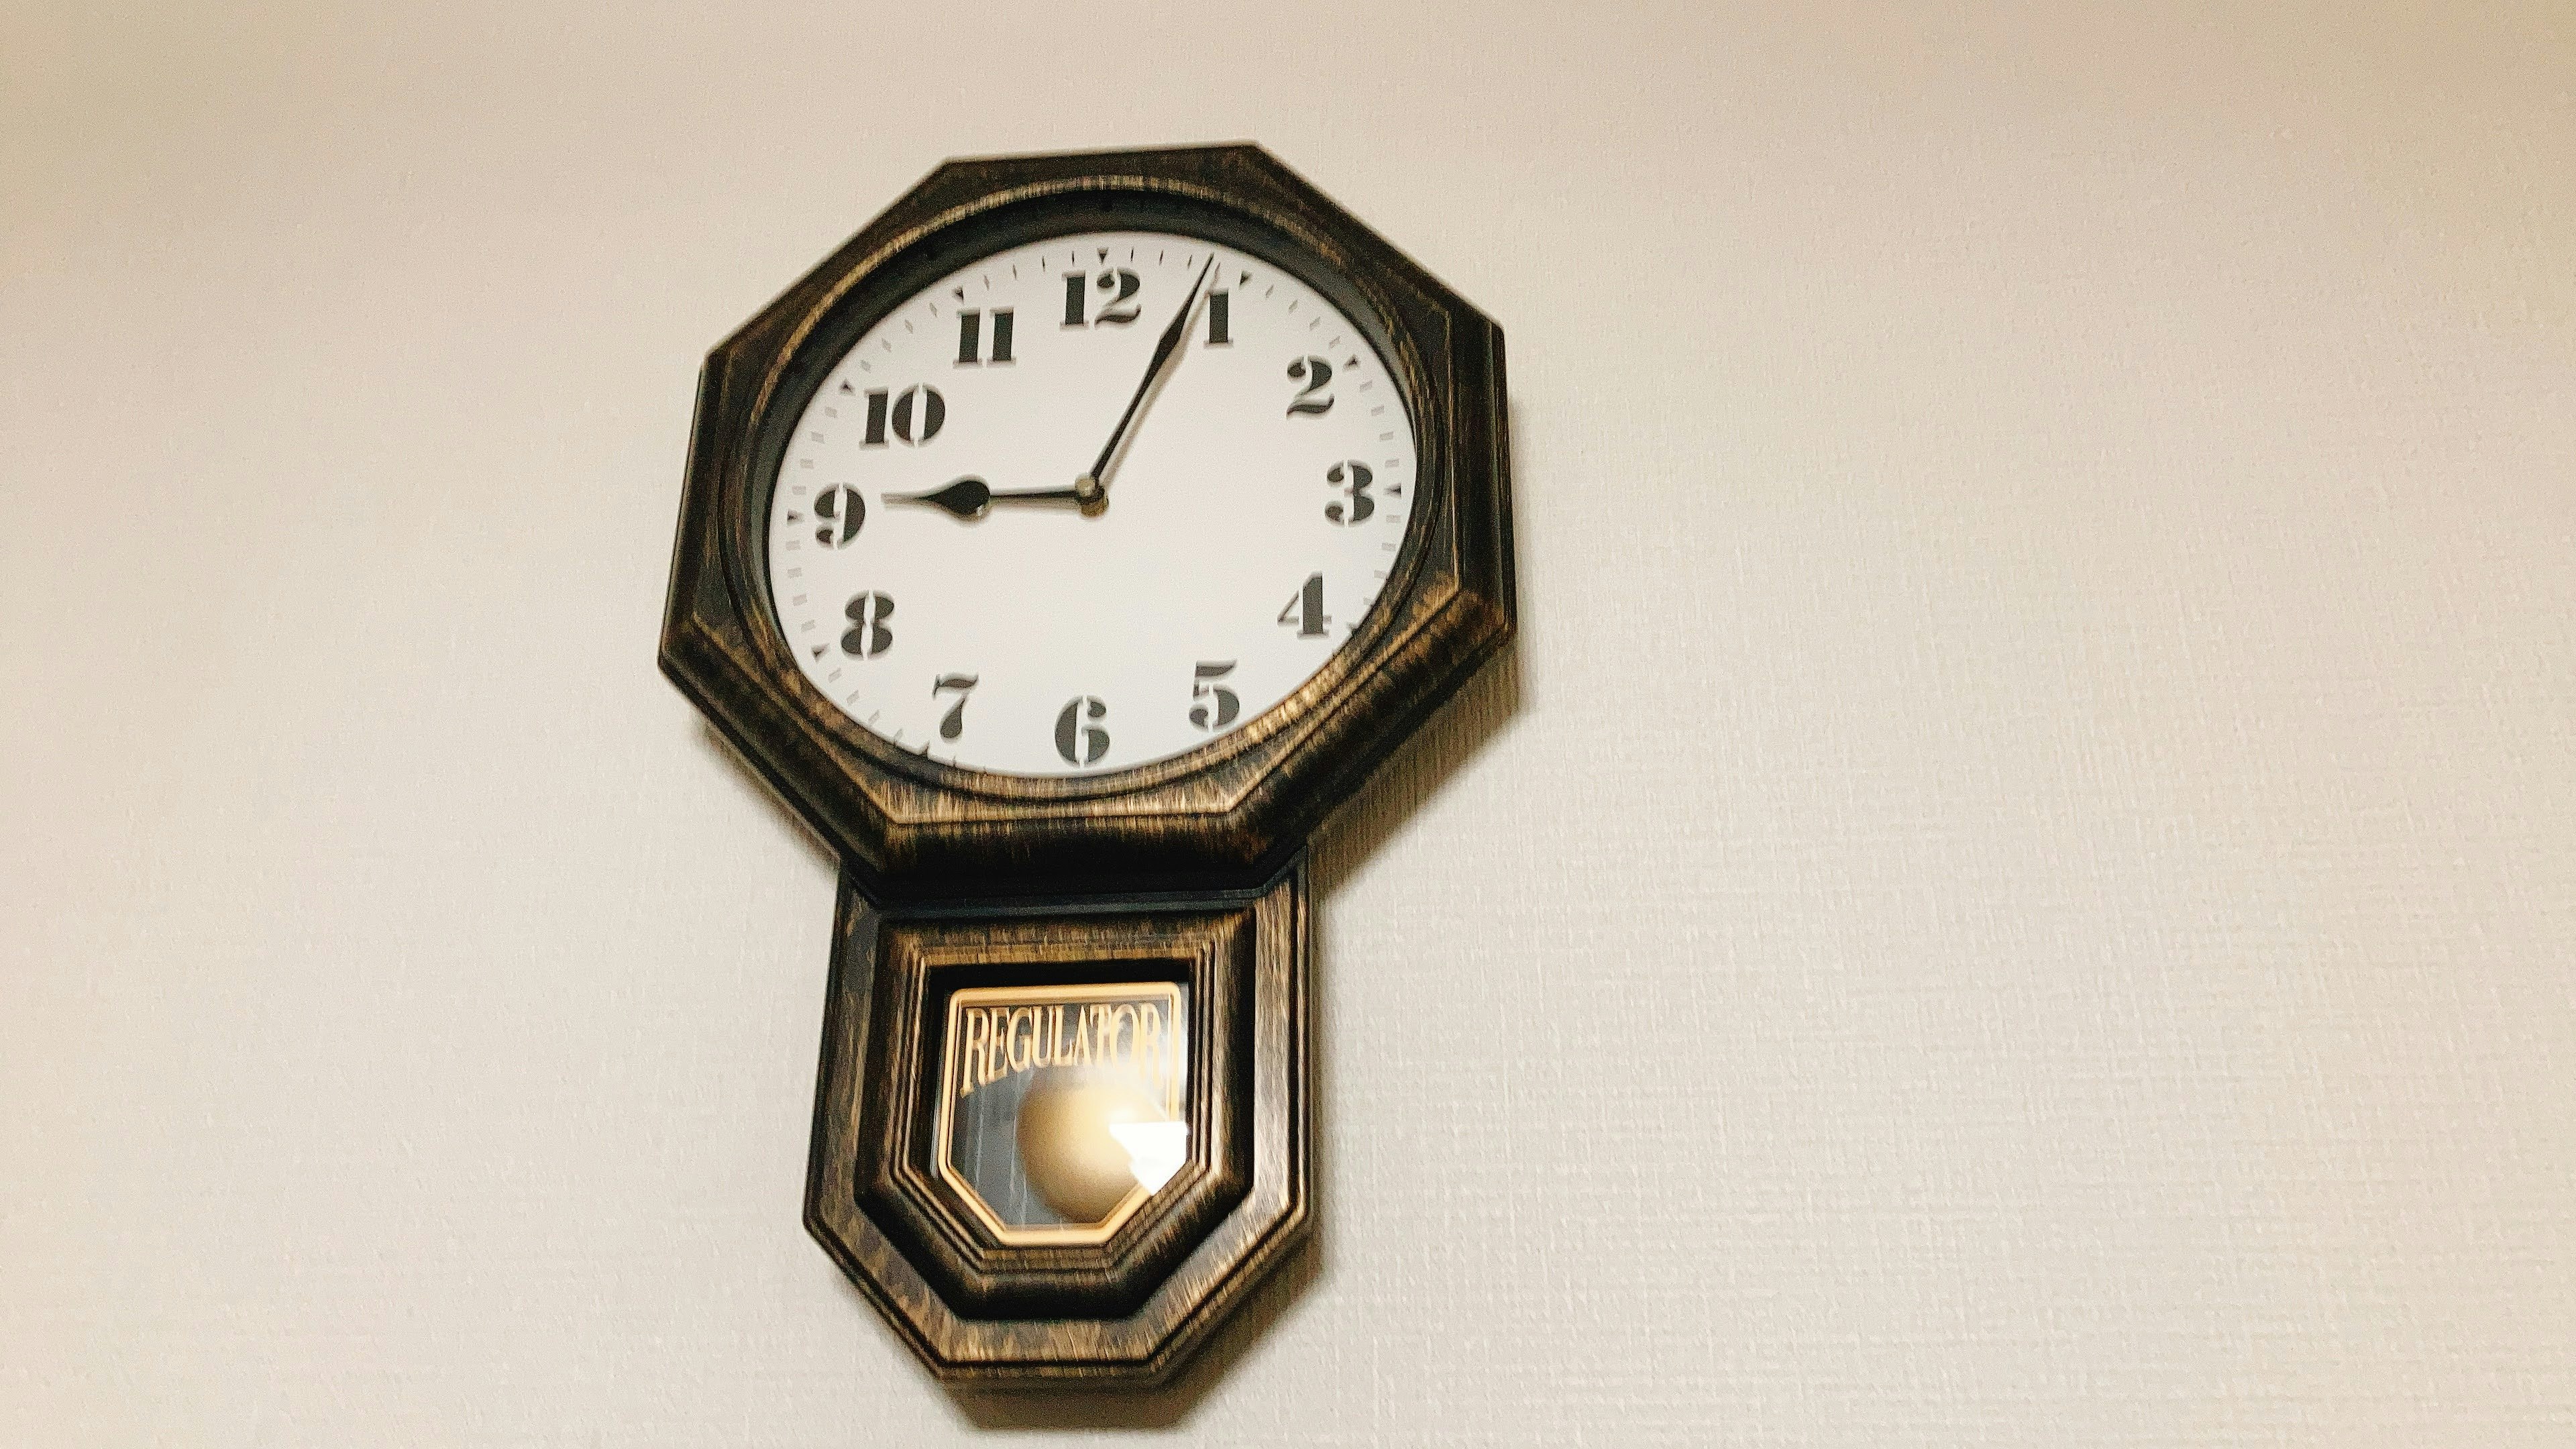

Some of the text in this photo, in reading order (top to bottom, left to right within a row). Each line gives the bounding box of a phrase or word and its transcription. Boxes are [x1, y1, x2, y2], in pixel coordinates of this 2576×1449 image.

[1059, 268, 1142, 327] 12
[1203, 289, 1234, 348] 1
[953, 306, 1016, 367] 11
[859, 383, 947, 447] 10
[1287, 356, 1335, 417] 2
[814, 484, 866, 547] 9
[1326, 460, 1375, 526] 3
[841, 591, 895, 657] 8
[1277, 572, 1332, 637] 4
[932, 674, 979, 741] 7
[1189, 659, 1241, 731] 5
[1055, 696, 1110, 766] 6
[959, 1003, 1163, 1098] REGULATOR
